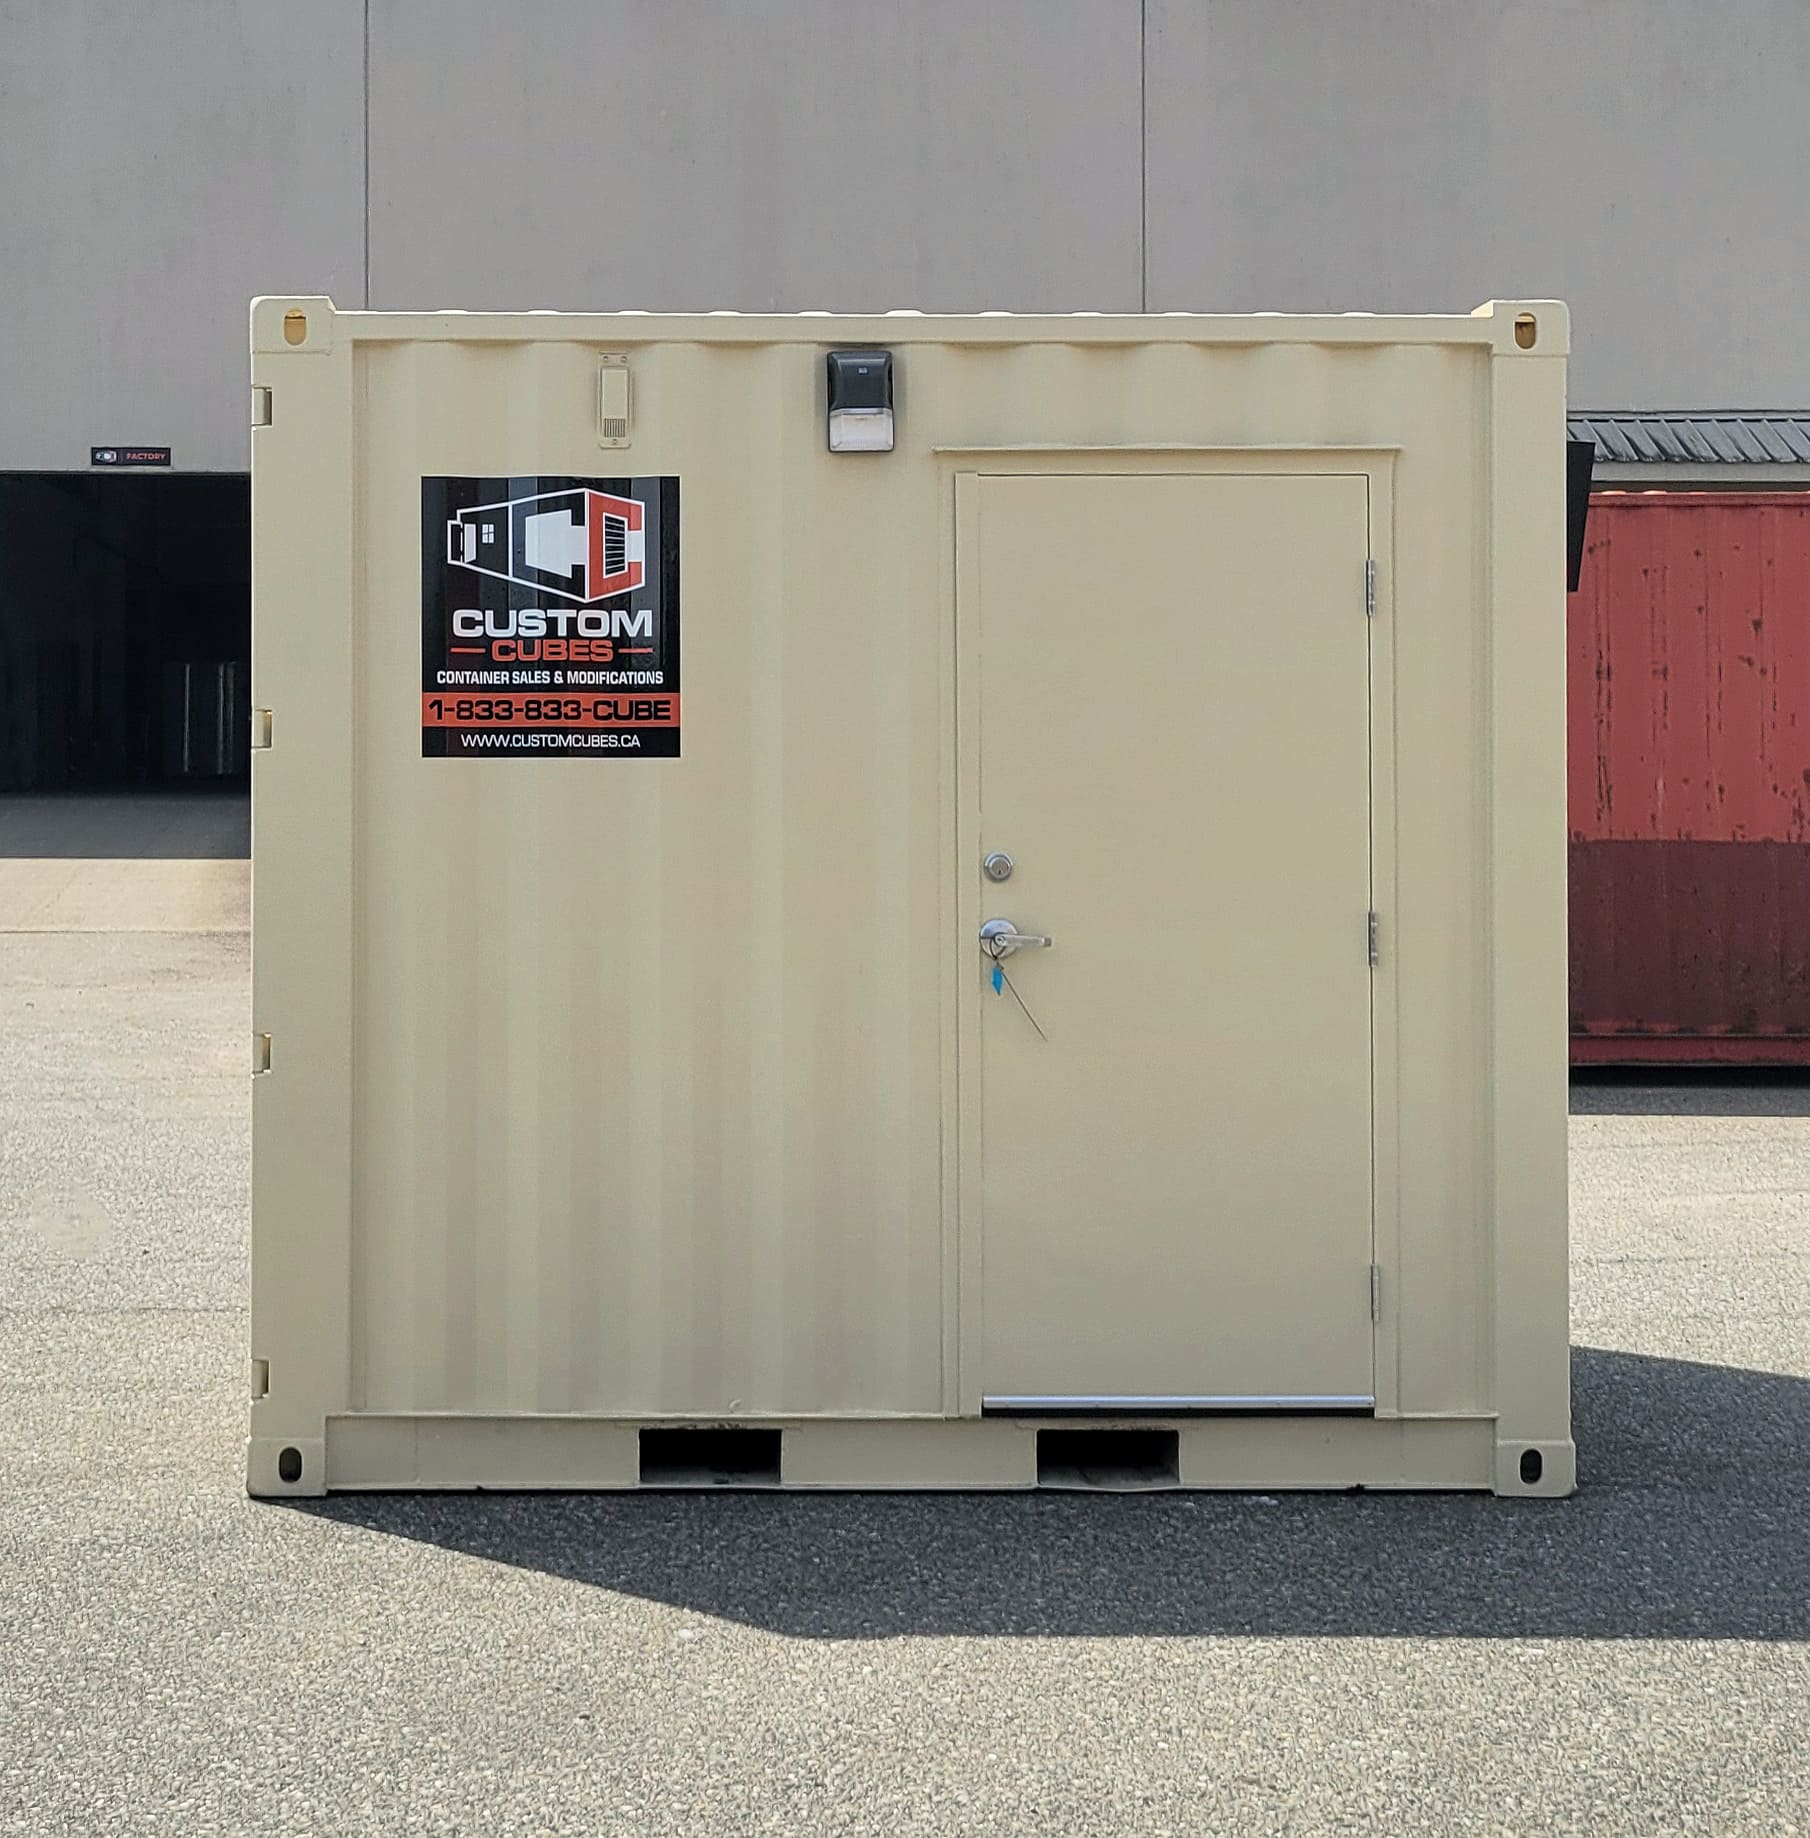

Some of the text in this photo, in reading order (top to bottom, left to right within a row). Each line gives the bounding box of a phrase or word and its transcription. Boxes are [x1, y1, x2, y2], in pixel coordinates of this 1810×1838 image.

[126, 452, 166, 460] FACTORY
[452, 609, 653, 637] CUSTOM
[491, 639, 613, 662] CUBES
[436, 670, 664, 685] CONTAINER SALES & MODIFICATIONS
[428, 699, 671, 721] 1-833-833-CUBE
[461, 734, 640, 749] WWW.CUSTOMCUBES.CA
